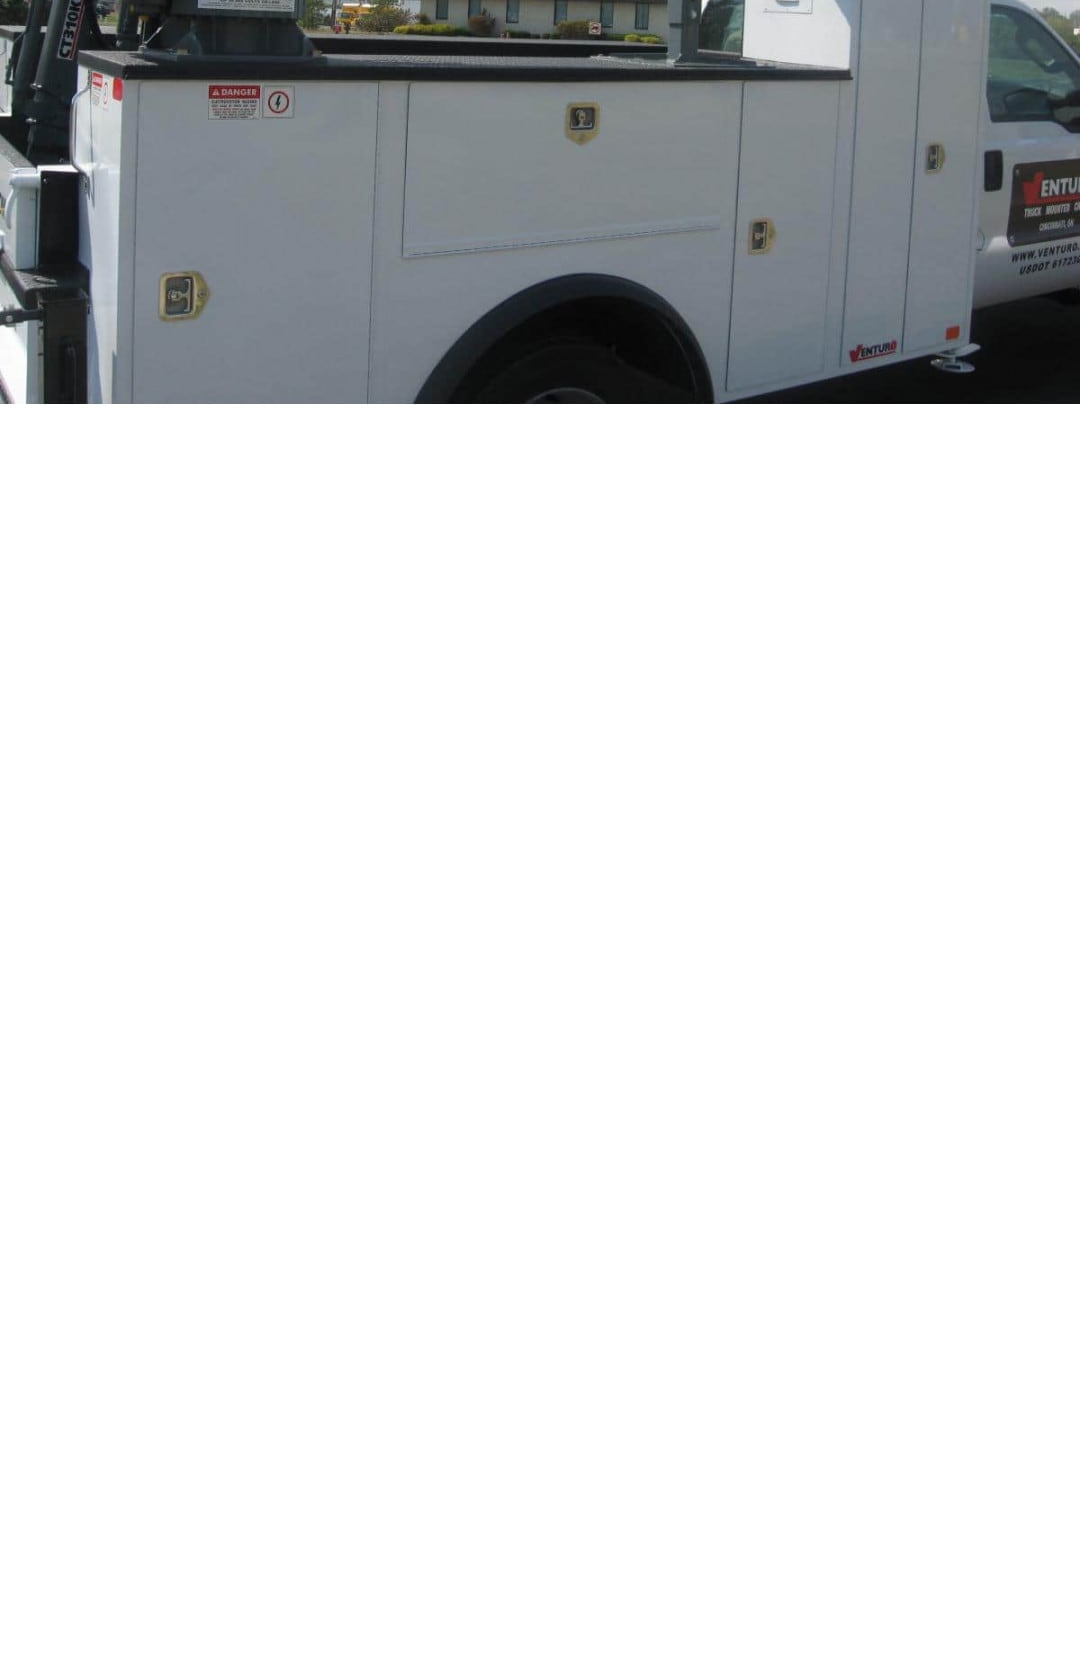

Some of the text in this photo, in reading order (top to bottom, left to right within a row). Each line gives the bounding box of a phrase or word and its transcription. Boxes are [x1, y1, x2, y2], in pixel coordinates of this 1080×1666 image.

[221, 88, 257, 96] DANGER
[1019, 260, 1051, 275] USDOT
[849, 340, 897, 362] VENTURO
